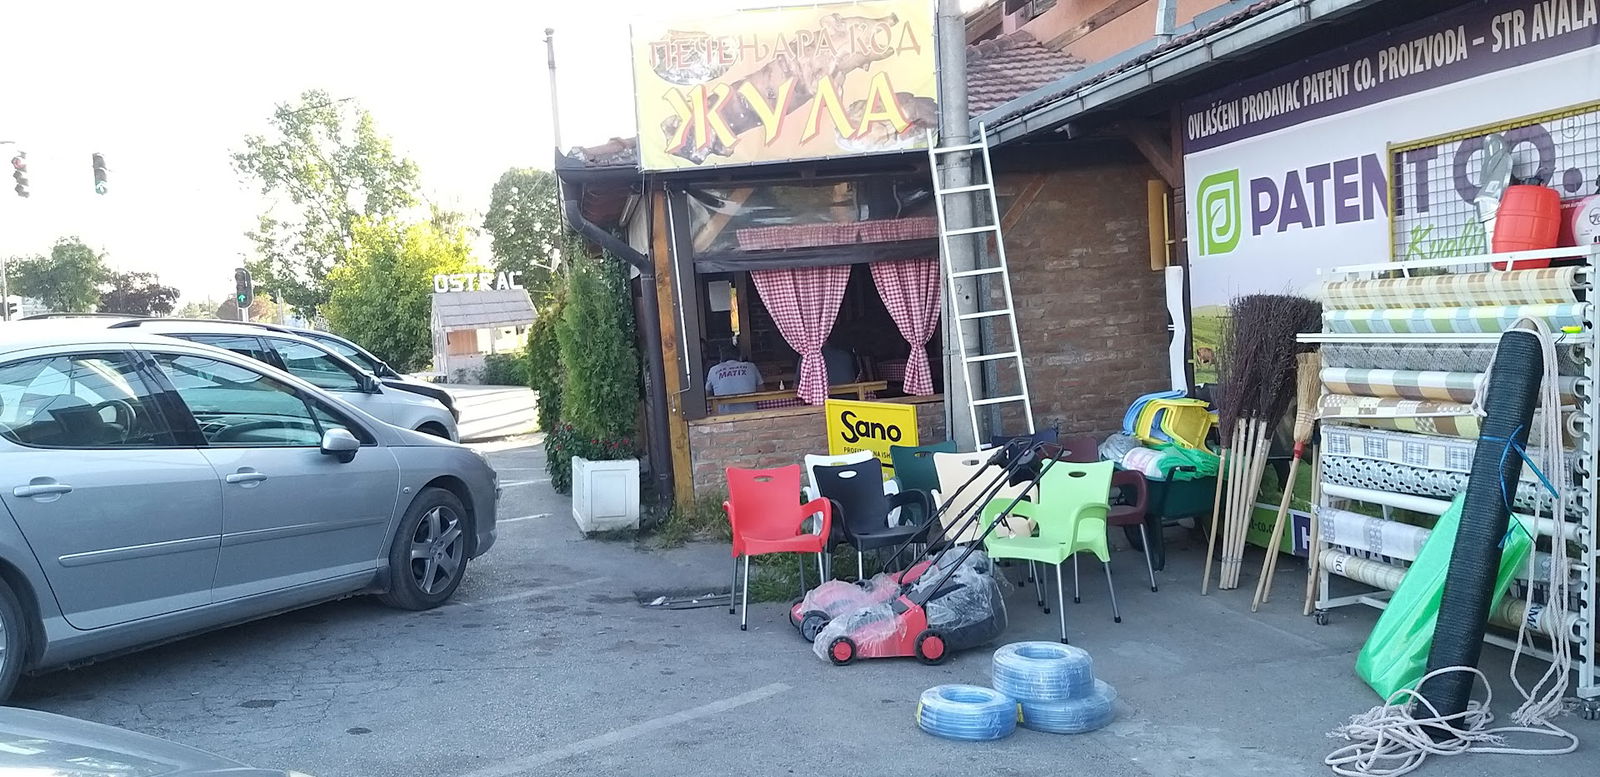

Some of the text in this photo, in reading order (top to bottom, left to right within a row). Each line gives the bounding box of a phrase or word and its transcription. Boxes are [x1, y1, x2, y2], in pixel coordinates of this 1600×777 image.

[648, 22, 921, 70] ПЕЧЕЊАРА КОД
[1188, 100, 1240, 140] OVLAŠĆENI
[1242, 83, 1300, 125] PRODAVAC
[1303, 65, 1350, 107] PATENT
[1353, 59, 1376, 92] CO.
[1378, 25, 1468, 83] PROIZVODA
[1491, 9, 1527, 53] STR
[1531, 0, 1598, 42] AVALA
[661, 71, 913, 155] ЖУЛА
[1250, 144, 1439, 236] PATENT
[434, 270, 524, 293] OSTRAC
[841, 410, 902, 443] Sano
